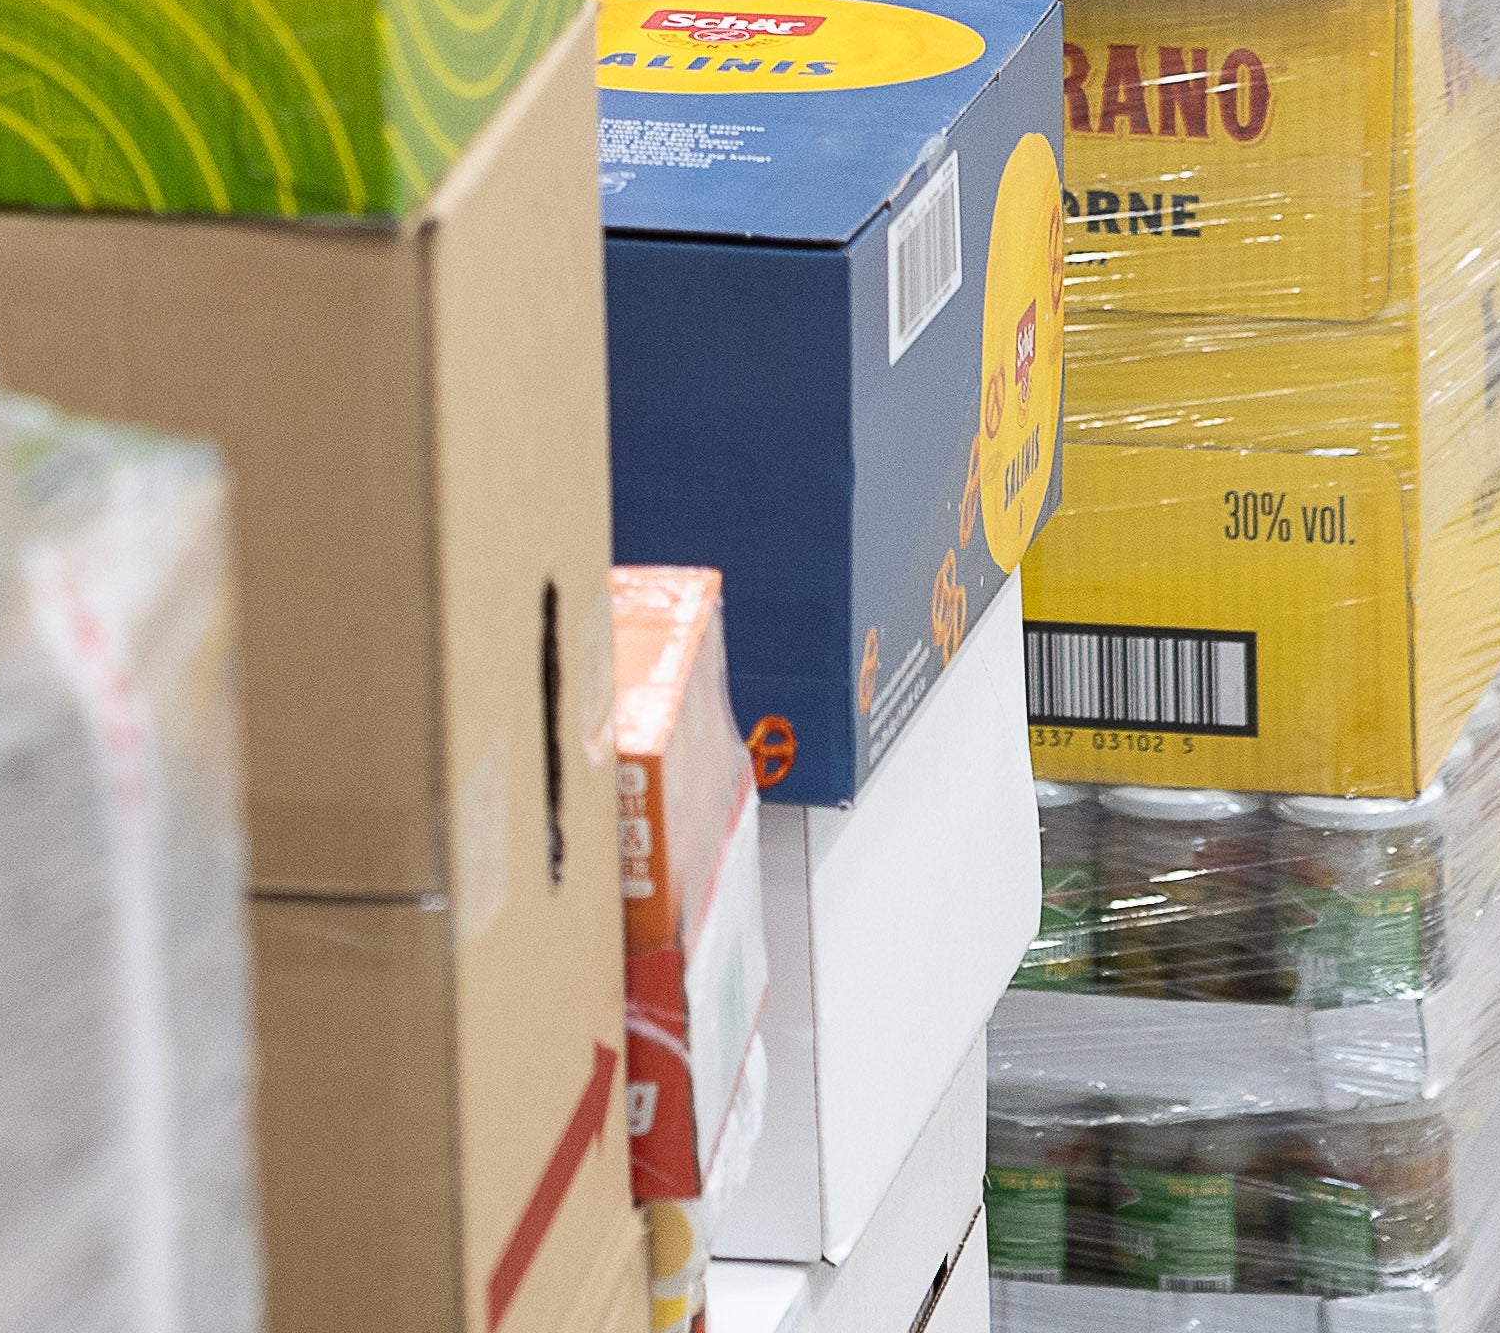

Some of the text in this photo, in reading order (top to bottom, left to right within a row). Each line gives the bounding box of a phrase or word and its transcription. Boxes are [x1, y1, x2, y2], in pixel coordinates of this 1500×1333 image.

[661, 12, 805, 35] Schär
[1224, 490, 1356, 546] 30% vol.
